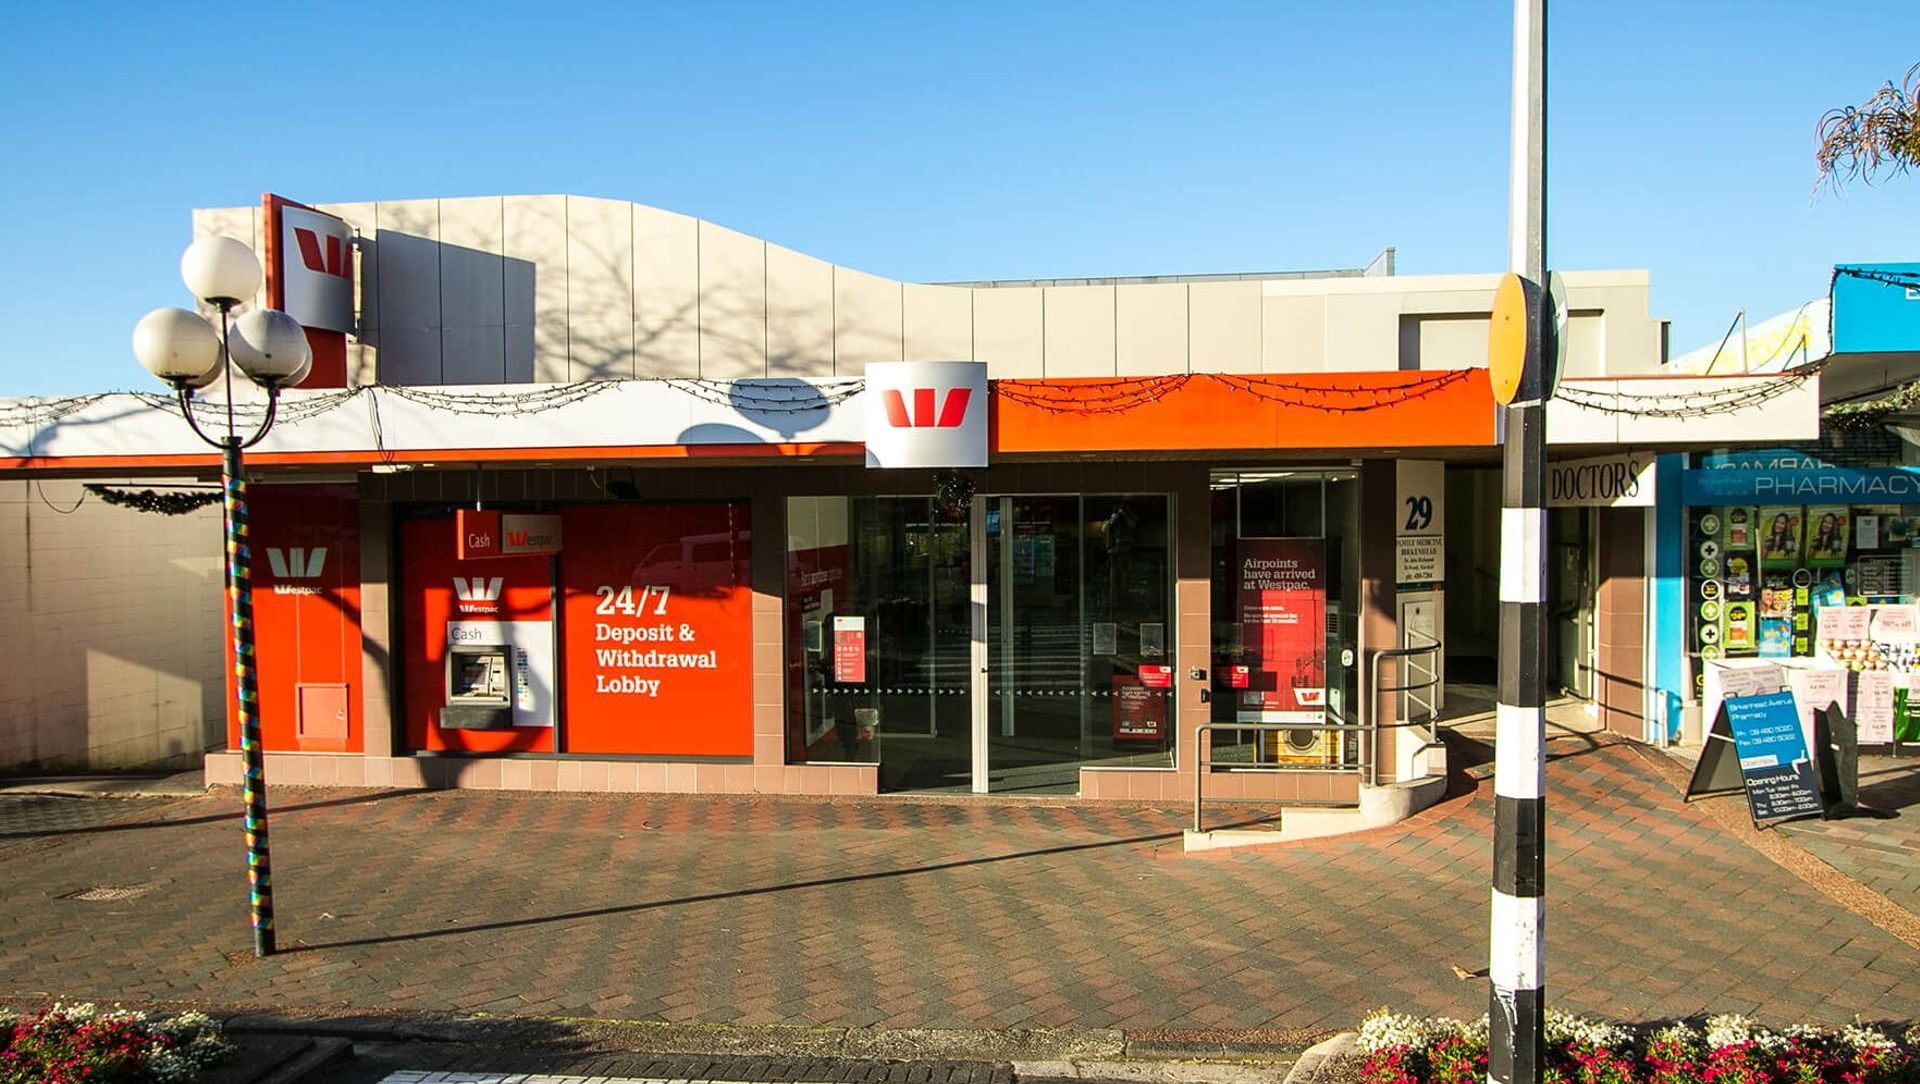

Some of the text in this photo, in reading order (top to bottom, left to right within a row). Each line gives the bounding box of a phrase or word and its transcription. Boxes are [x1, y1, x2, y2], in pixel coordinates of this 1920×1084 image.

[1551, 460, 1640, 500] DOCTORS
[1405, 496, 1433, 530] 29
[468, 533, 490, 549] Cash
[1244, 558, 1298, 570] Airpoints
[1244, 568, 1316, 579] have arrived
[274, 584, 323, 597] Westpac
[1244, 579, 1311, 592] at Westpac.
[459, 604, 500, 614] Westpac
[595, 585, 671, 618] 24/7
[451, 627, 482, 641] Cash
[595, 624, 695, 645] Deposit &
[596, 649, 717, 670] Withdrawal
[596, 675, 661, 698] Lobby
[1746, 774, 1800, 787] Opening Hours
